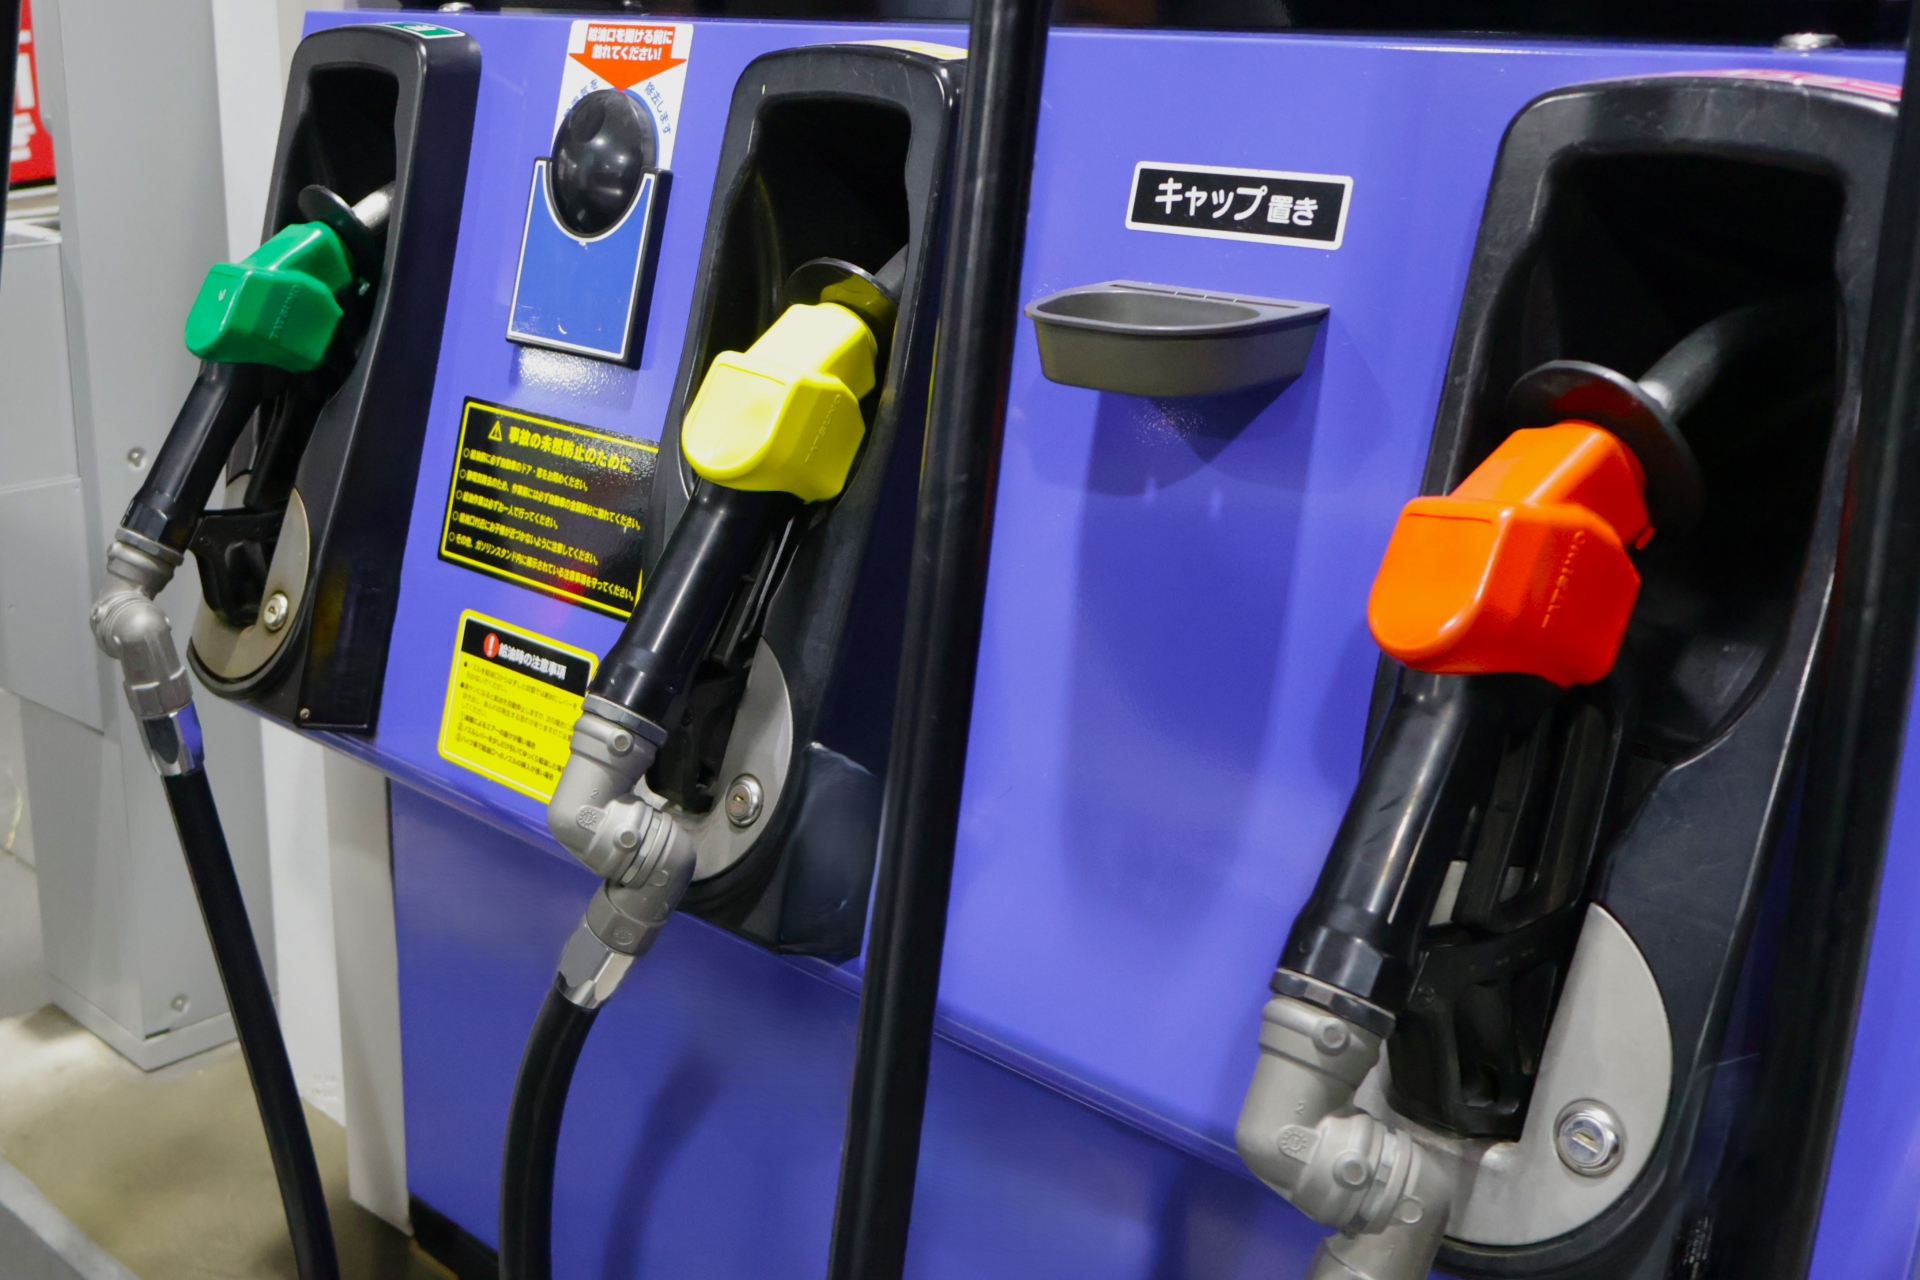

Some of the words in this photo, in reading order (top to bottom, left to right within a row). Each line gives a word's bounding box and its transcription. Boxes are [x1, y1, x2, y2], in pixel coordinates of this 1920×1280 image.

[587, 27, 674, 45] 給油口を開ける前に
[645, 81, 671, 134] 除去します
[1155, 177, 1319, 226] キャップ置き
[508, 426, 632, 473] 事故の未然防止のために
[498, 643, 567, 681] 給油時の注意事項
